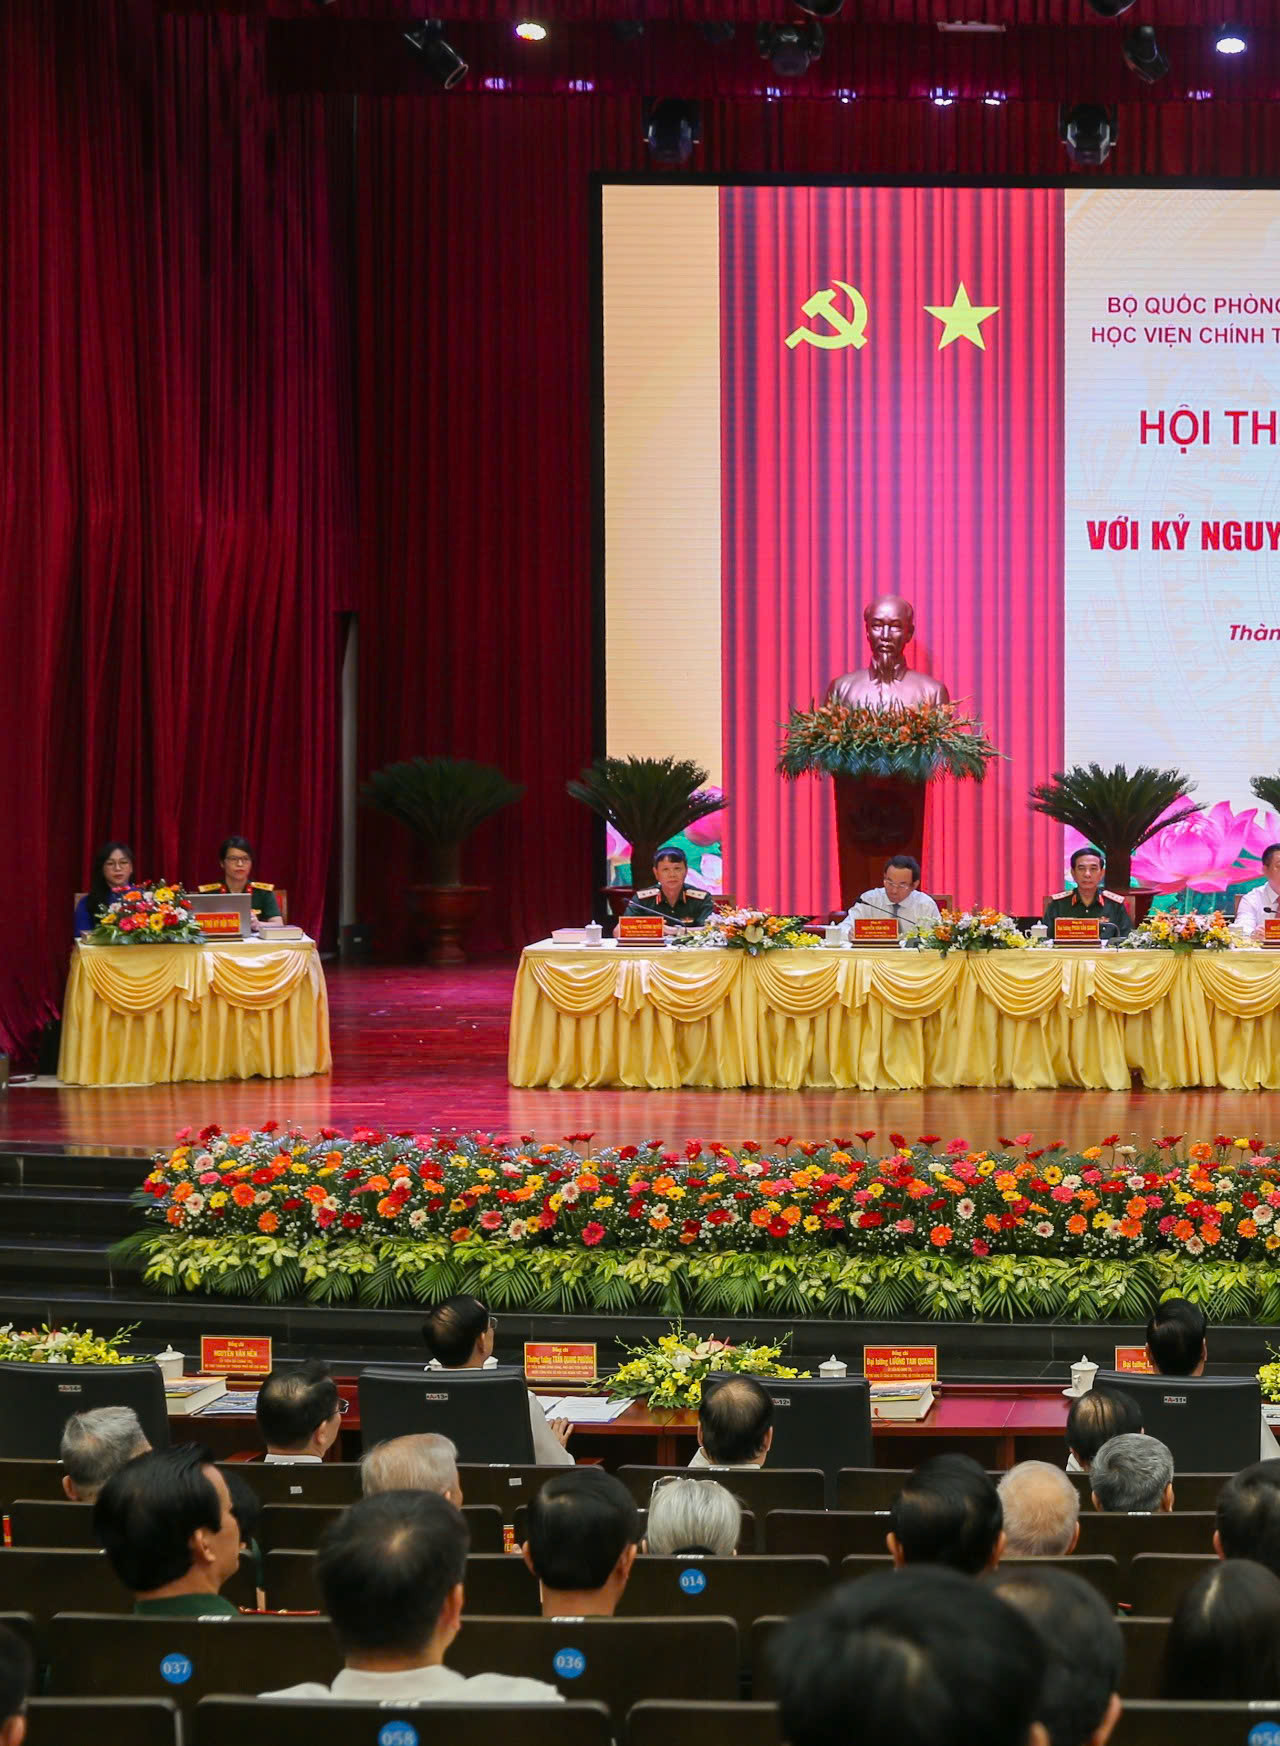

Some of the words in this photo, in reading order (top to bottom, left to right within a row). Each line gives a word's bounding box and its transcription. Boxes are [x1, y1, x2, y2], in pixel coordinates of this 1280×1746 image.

[1092, 326, 1136, 347] HỌC
[1200, 323, 1264, 344] CHÍNH
[1141, 404, 1210, 454] HỘI
[1087, 516, 1139, 551] VỚI
[1152, 514, 1190, 550] KỶ
[681, 1575, 703, 1587] 014
[163, 1661, 189, 1674] 037
[556, 1655, 583, 1669] 036
